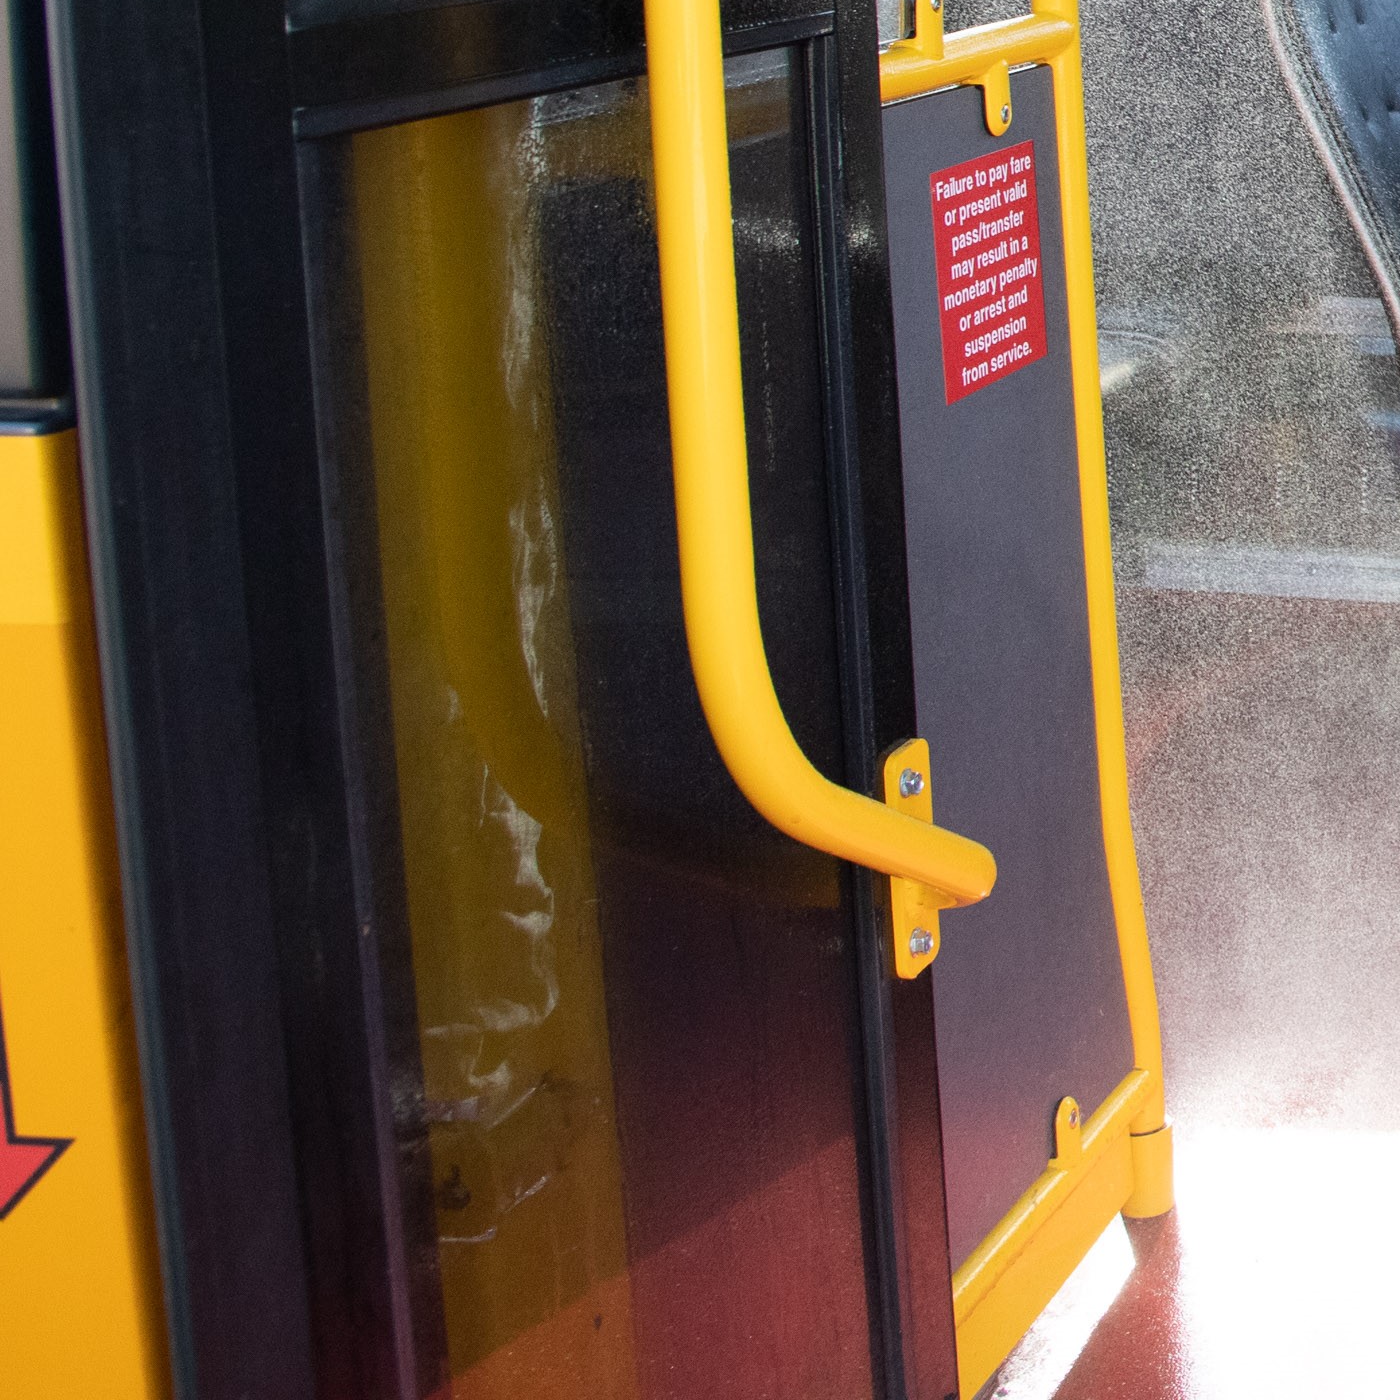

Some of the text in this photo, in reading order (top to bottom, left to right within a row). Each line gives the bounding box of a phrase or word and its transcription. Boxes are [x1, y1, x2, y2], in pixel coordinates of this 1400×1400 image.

[936, 155, 1031, 201] Failure to pay fare
[944, 179, 1027, 226] or present valid
[952, 210, 1024, 257] pass/transfer
[951, 236, 1028, 280] may result in a
[944, 258, 1038, 311] monetary penalty
[960, 284, 1028, 332] or arrest and
[964, 316, 1027, 358] suspension
[962, 341, 1033, 386] from service.
